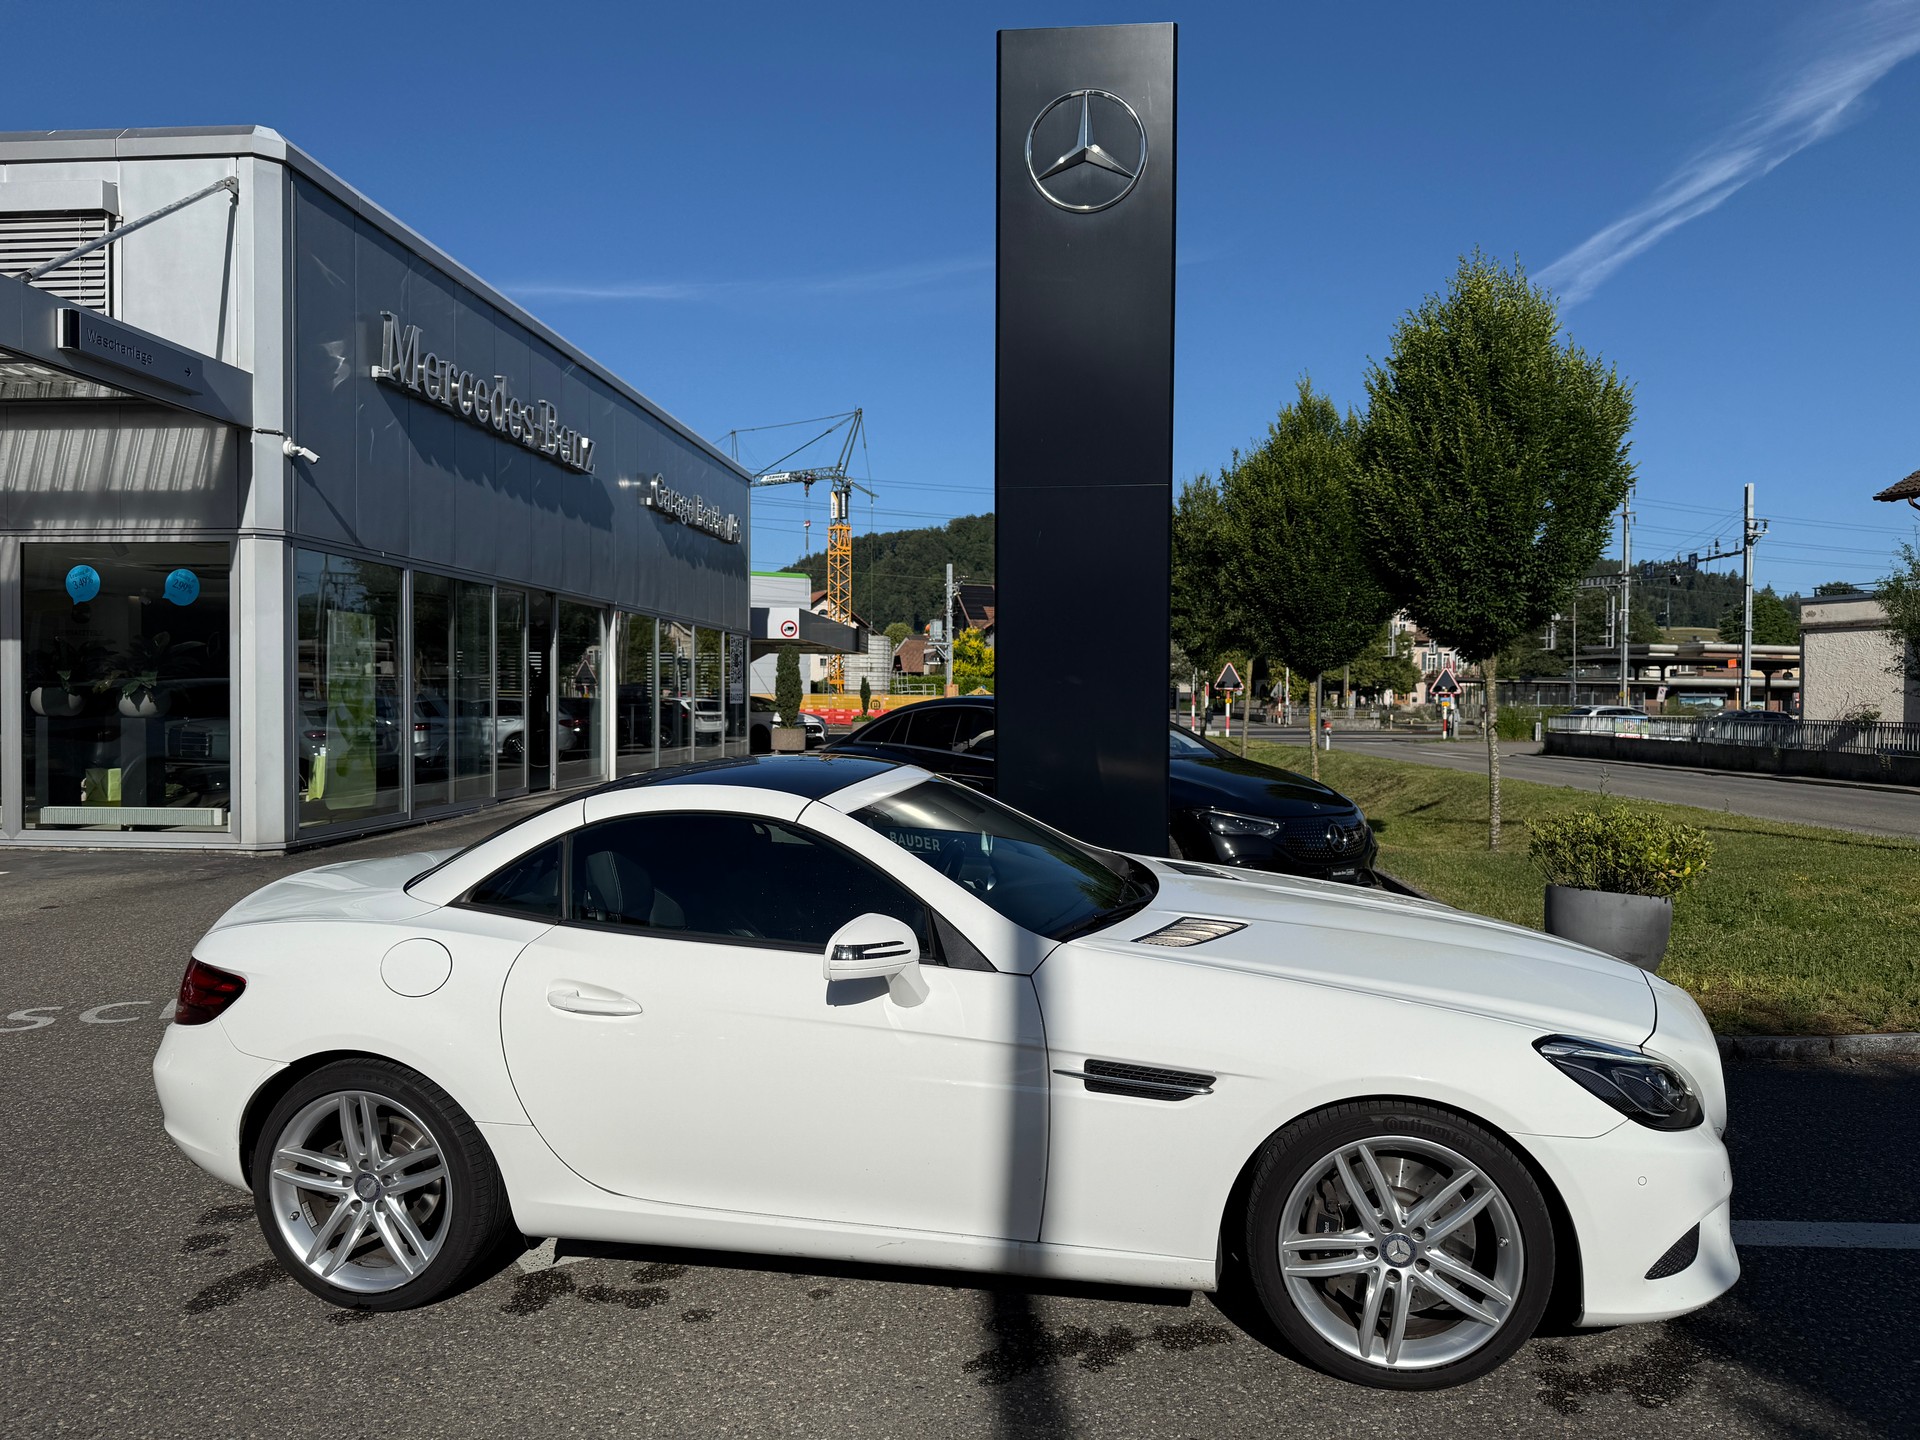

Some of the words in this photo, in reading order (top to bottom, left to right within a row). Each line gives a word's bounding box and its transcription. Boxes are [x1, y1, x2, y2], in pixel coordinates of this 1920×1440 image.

[86, 327, 154, 366] Waschanlage
[379, 310, 597, 475] Mercedes-Benz
[652, 472, 694, 526] Garage
[889, 831, 941, 852] BAUDER
[1382, 1115, 1472, 1148] Continental
